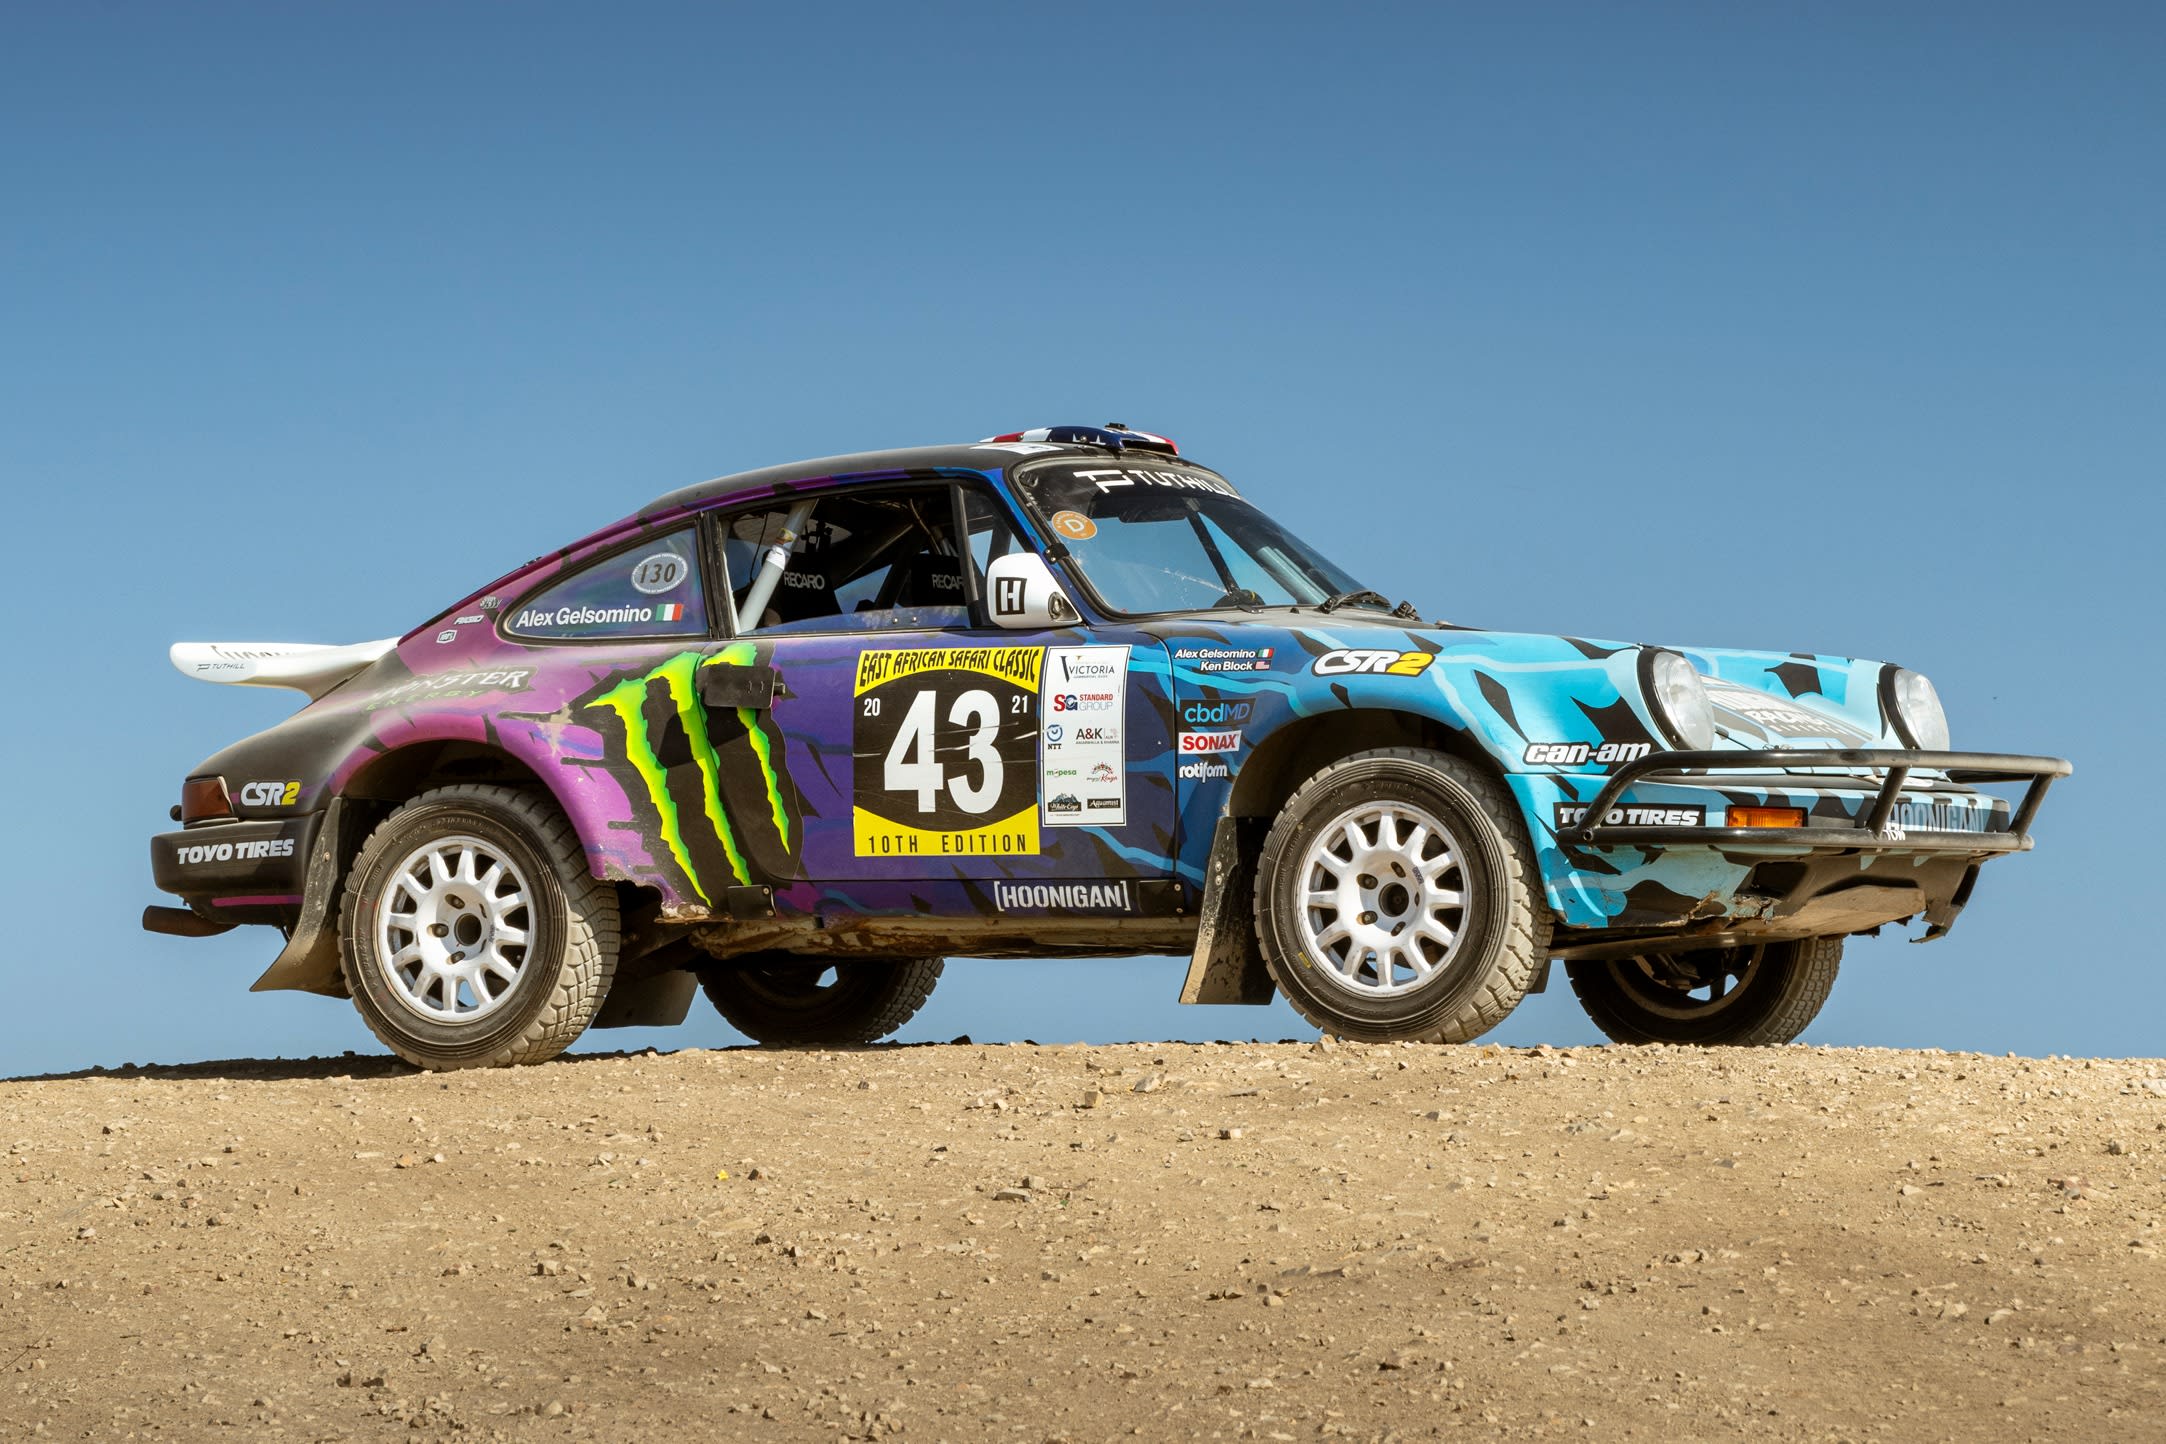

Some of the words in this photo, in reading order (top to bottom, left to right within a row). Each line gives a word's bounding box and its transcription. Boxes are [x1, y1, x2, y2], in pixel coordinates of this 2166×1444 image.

[1127, 469, 1241, 500] TUTHILL
[1064, 519, 1085, 533] D
[640, 562, 676, 584] 130
[783, 571, 825, 590] RECARO
[931, 574, 965, 590] RECAR
[1000, 580, 1020, 612] H
[516, 610, 554, 628] Alex
[556, 604, 652, 625] Gelsomino
[1175, 649, 1198, 659] Alex
[1199, 649, 1256, 659] Gelsomino
[1314, 650, 1434, 676] CSR2
[859, 653, 892, 688] EAST
[893, 651, 946, 675] AFRICAN
[948, 650, 991, 670] SAFARI
[993, 648, 1040, 684] CLASSIC
[1068, 665, 1115, 675] VICTORIA
[1201, 662, 1221, 671] Ken
[1222, 661, 1253, 671] Block
[1011, 695, 1028, 714] 21
[1079, 693, 1114, 702] STANDARD
[1079, 701, 1113, 711] GROUP
[863, 698, 881, 717] 20
[1184, 703, 1251, 723] cbdMD
[1075, 728, 1103, 740] A&K
[1182, 734, 1237, 751] SONAX
[884, 689, 1004, 814] 43
[1525, 742, 1651, 763] can-am
[1179, 761, 1228, 783] rotiform
[240, 781, 301, 807] CSR2
[1559, 807, 1624, 825] TOO
[1626, 810, 1700, 826] TIRES
[177, 843, 233, 865] TOYO
[235, 838, 295, 860] TIRES
[868, 835, 918, 854] 10TH
[941, 834, 1027, 853] EDITION
